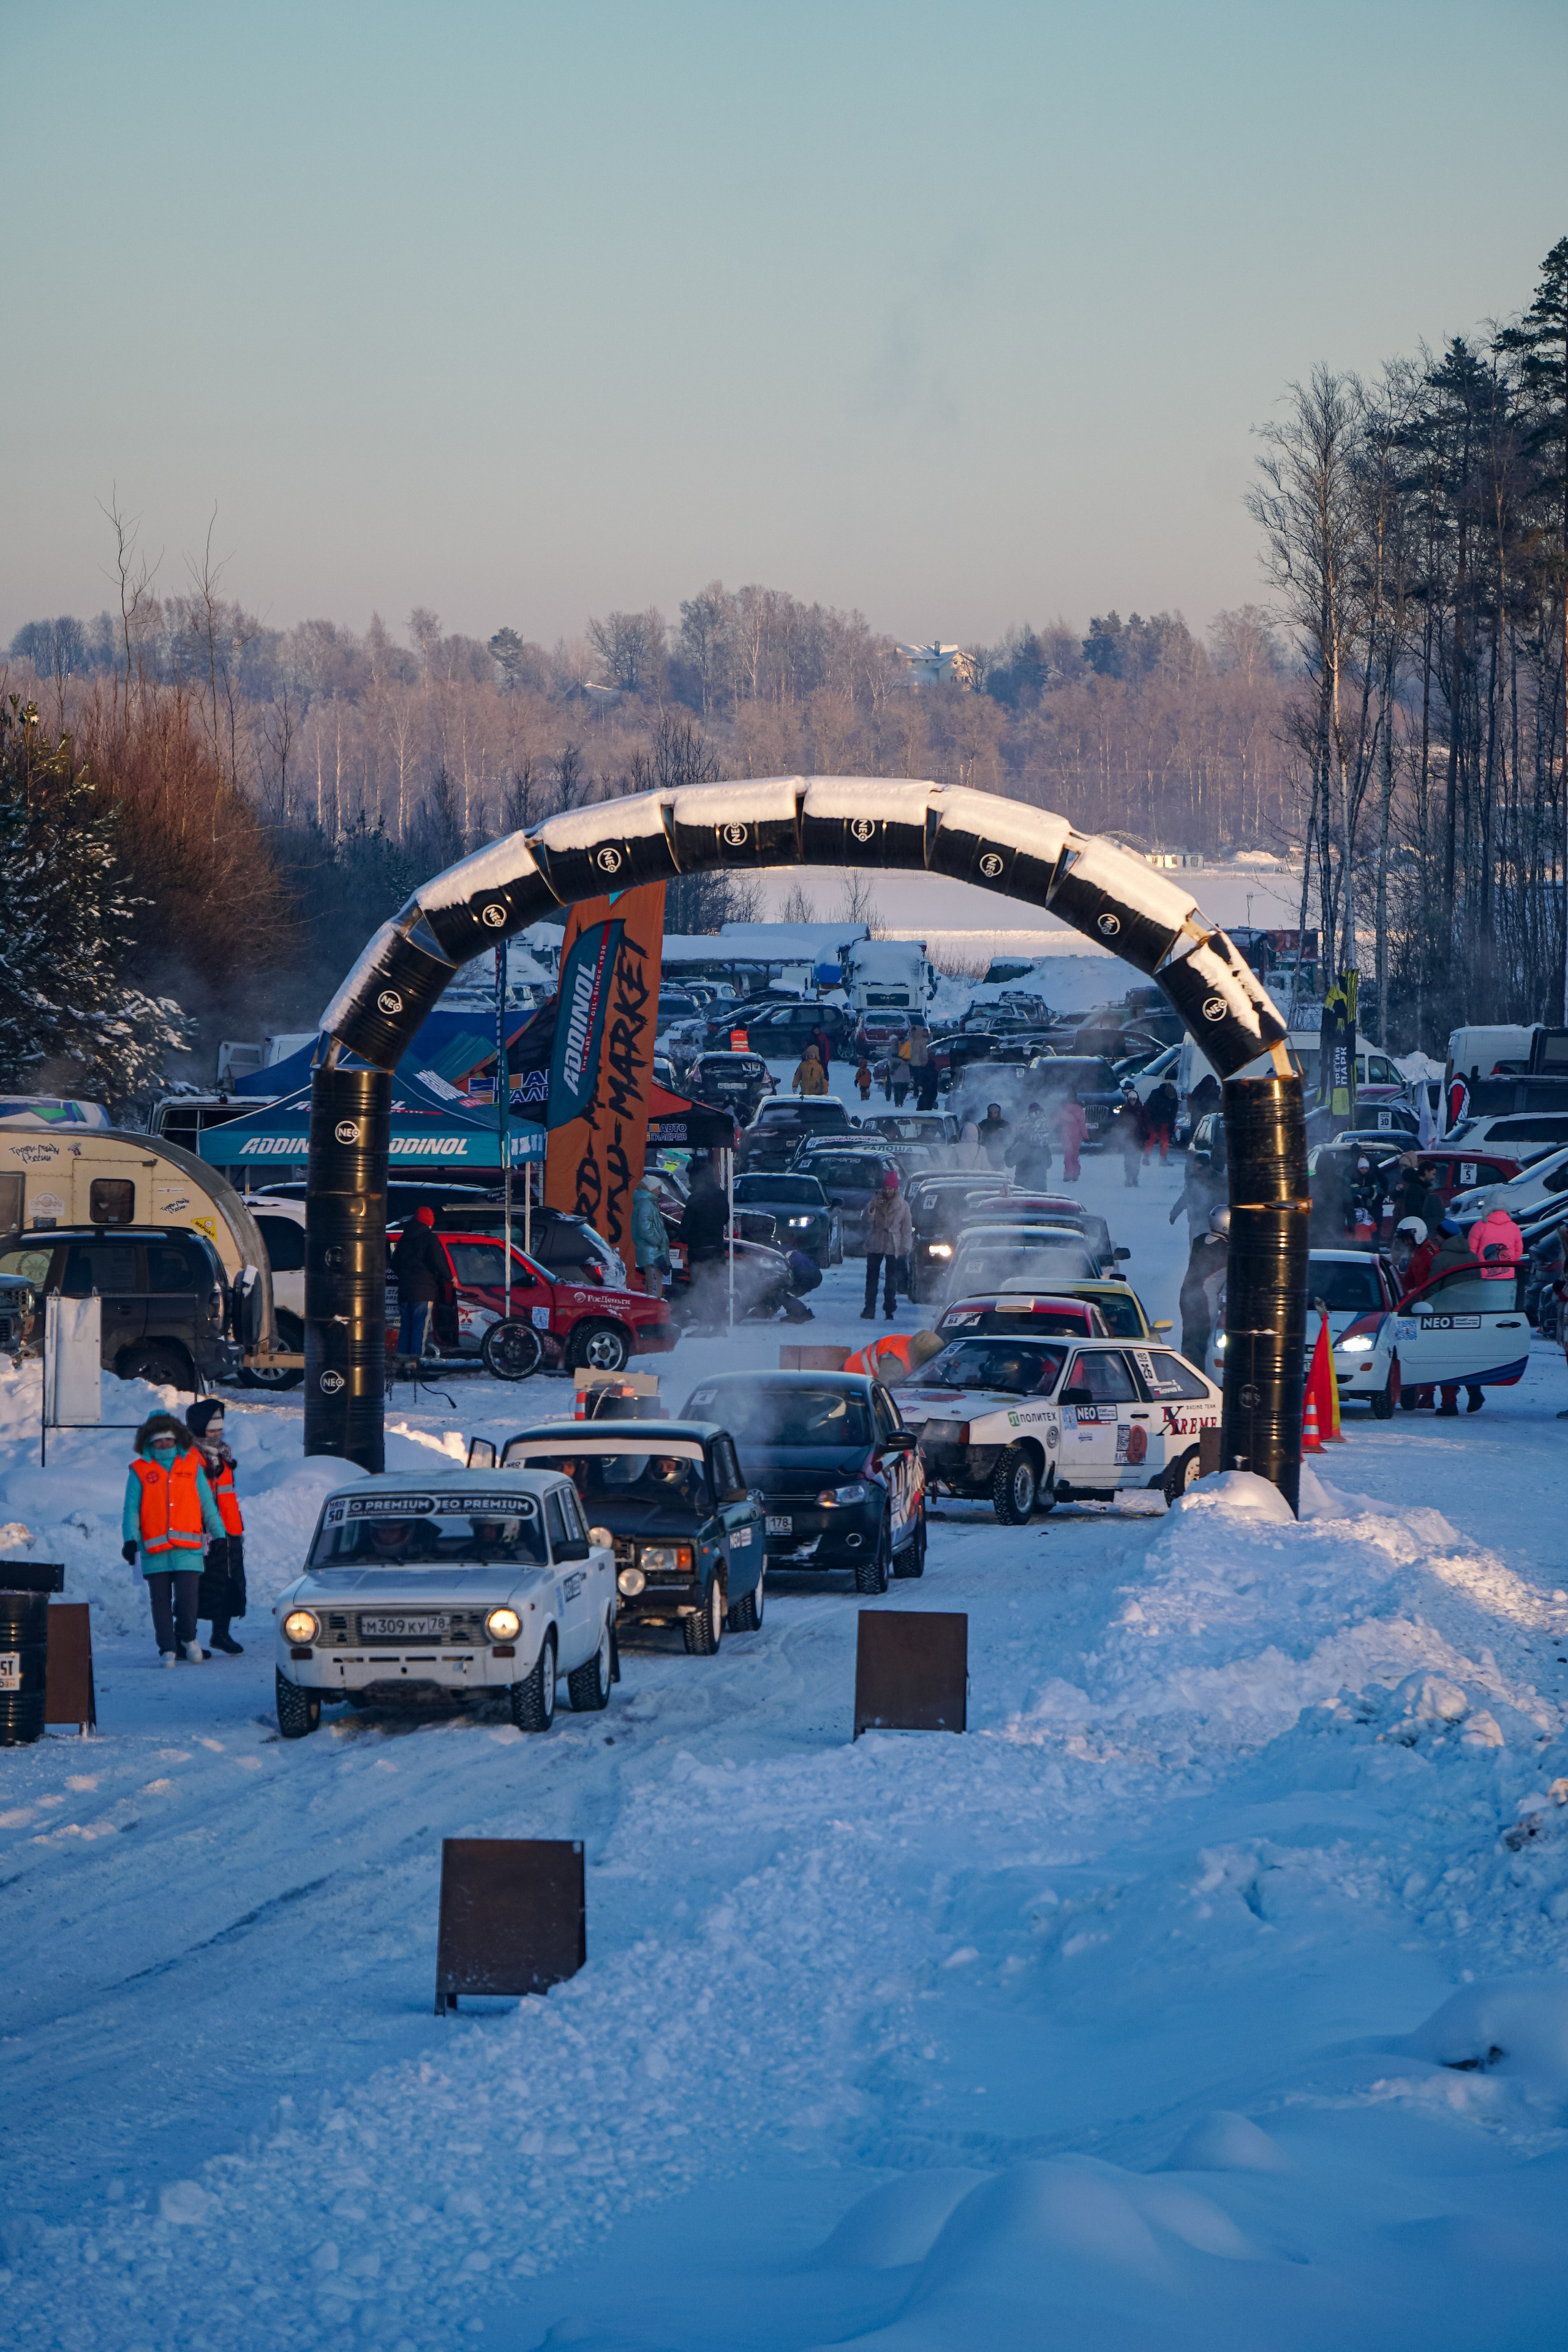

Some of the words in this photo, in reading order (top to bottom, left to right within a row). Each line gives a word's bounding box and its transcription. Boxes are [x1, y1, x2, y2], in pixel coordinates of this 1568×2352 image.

[381, 995, 403, 1012] NEO
[1205, 999, 1227, 1016] NEO
[564, 963, 596, 1096] ADDINOL
[660, 1123, 687, 1133] АВТО
[650, 1133, 687, 1141] ГАЛЕРЕЯ
[239, 1138, 309, 1154] ADDIN
[388, 1138, 468, 1154] DDINOL
[1466, 1170, 1471, 1180] 5
[195, 1221, 214, 1237] МАРШАЛ
[587, 1295, 631, 1305] РосДеньги
[1423, 1317, 1450, 1329] NEO
[1020, 1412, 1057, 1422] ПОЛИТЕХ
[1077, 1407, 1096, 1420] NEO
[365, 1499, 431, 1510] PREMIUM
[463, 1499, 529, 1511] PREMIUM
[328, 1509, 343, 1523] 50
[771, 1518, 788, 1527] 178
[431, 1618, 445, 1629] 78
